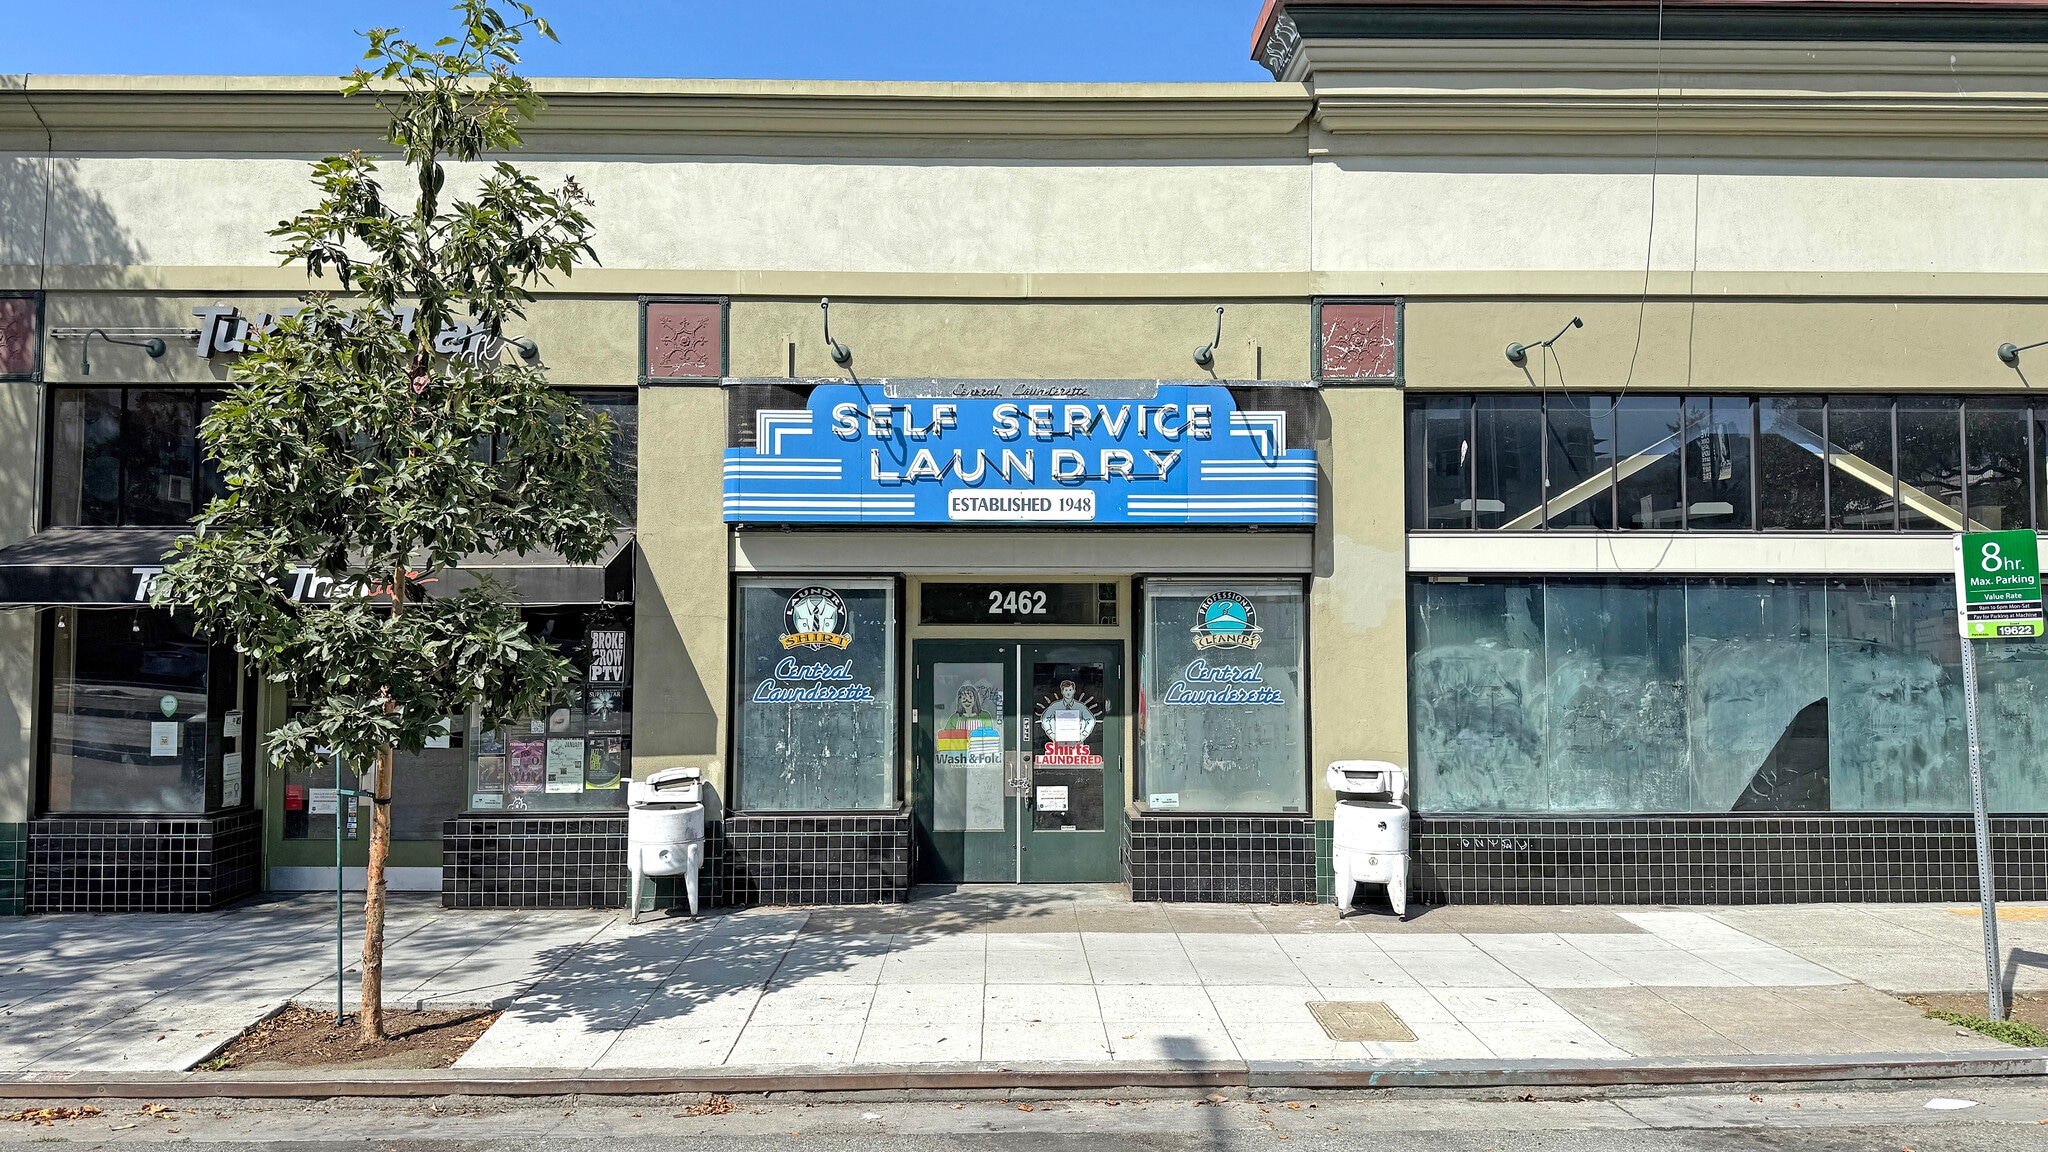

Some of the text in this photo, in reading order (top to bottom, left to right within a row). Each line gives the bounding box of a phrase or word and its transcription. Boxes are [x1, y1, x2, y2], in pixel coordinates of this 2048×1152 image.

[831, 403, 1212, 437] SELF SERVICE
[870, 448, 1184, 482] LAUNDRY
[951, 497, 1092, 513] ESTABLISHED 1948
[1970, 575, 2035, 586] Max. Parking
[786, 588, 844, 616] LAUNDRY
[988, 590, 1047, 614] 2462
[1199, 592, 1254, 617] PROFESSIONAL
[1984, 592, 2022, 601] Value Rate
[1999, 626, 2032, 636] 19622
[592, 632, 624, 649] BROKE
[785, 633, 847, 646] SHIRT
[1199, 634, 1254, 646] CLEANERS
[591, 665, 622, 681] PTV
[775, 656, 853, 680] Central
[1185, 658, 1263, 683] Central
[753, 678, 875, 703] Launderette
[1163, 680, 1285, 705] Launderette
[1045, 742, 1090, 756] Shirts
[935, 753, 967, 764] Wash
[978, 753, 1002, 764] Fold
[1035, 755, 1103, 765] LAUNDERED
